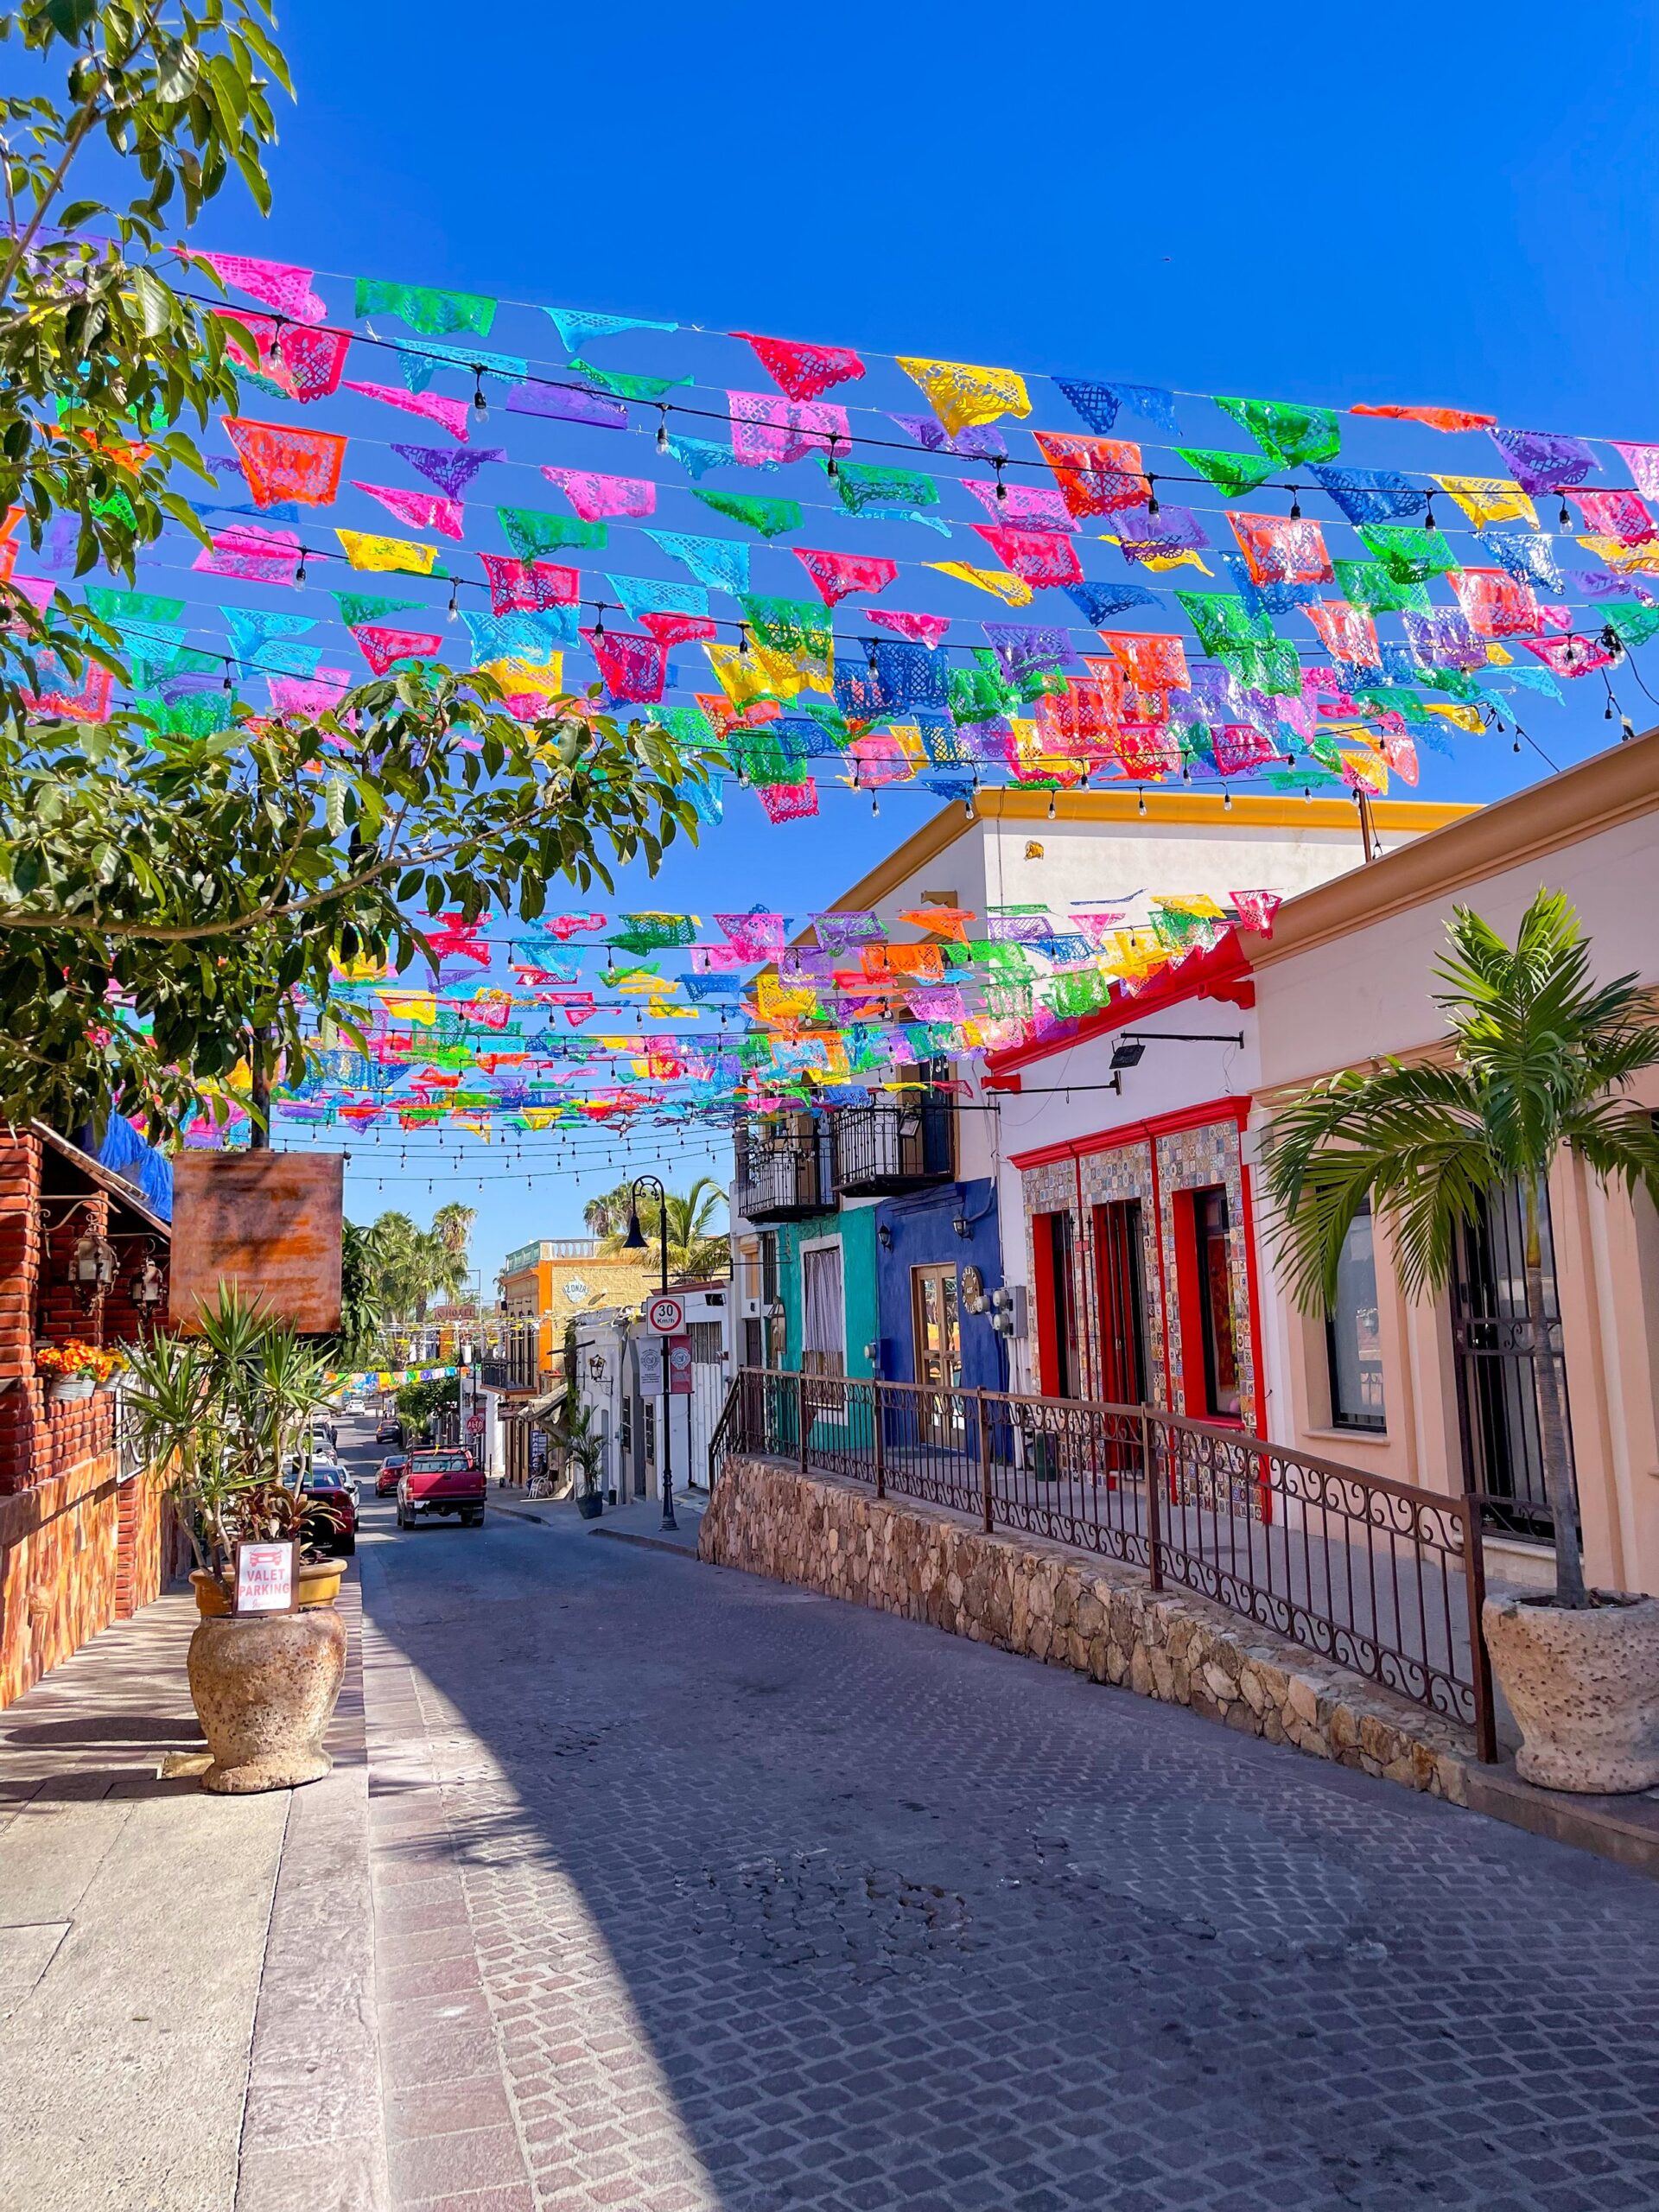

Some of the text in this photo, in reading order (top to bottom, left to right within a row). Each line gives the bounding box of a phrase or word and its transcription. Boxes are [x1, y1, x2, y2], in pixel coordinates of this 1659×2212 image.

[446, 1308, 474, 1317] HOTEL
[658, 1305, 673, 1317] 30
[467, 1421, 483, 1429] ALTO
[247, 1569, 285, 1581] VALET
[238, 1583, 289, 1597] PARKING
